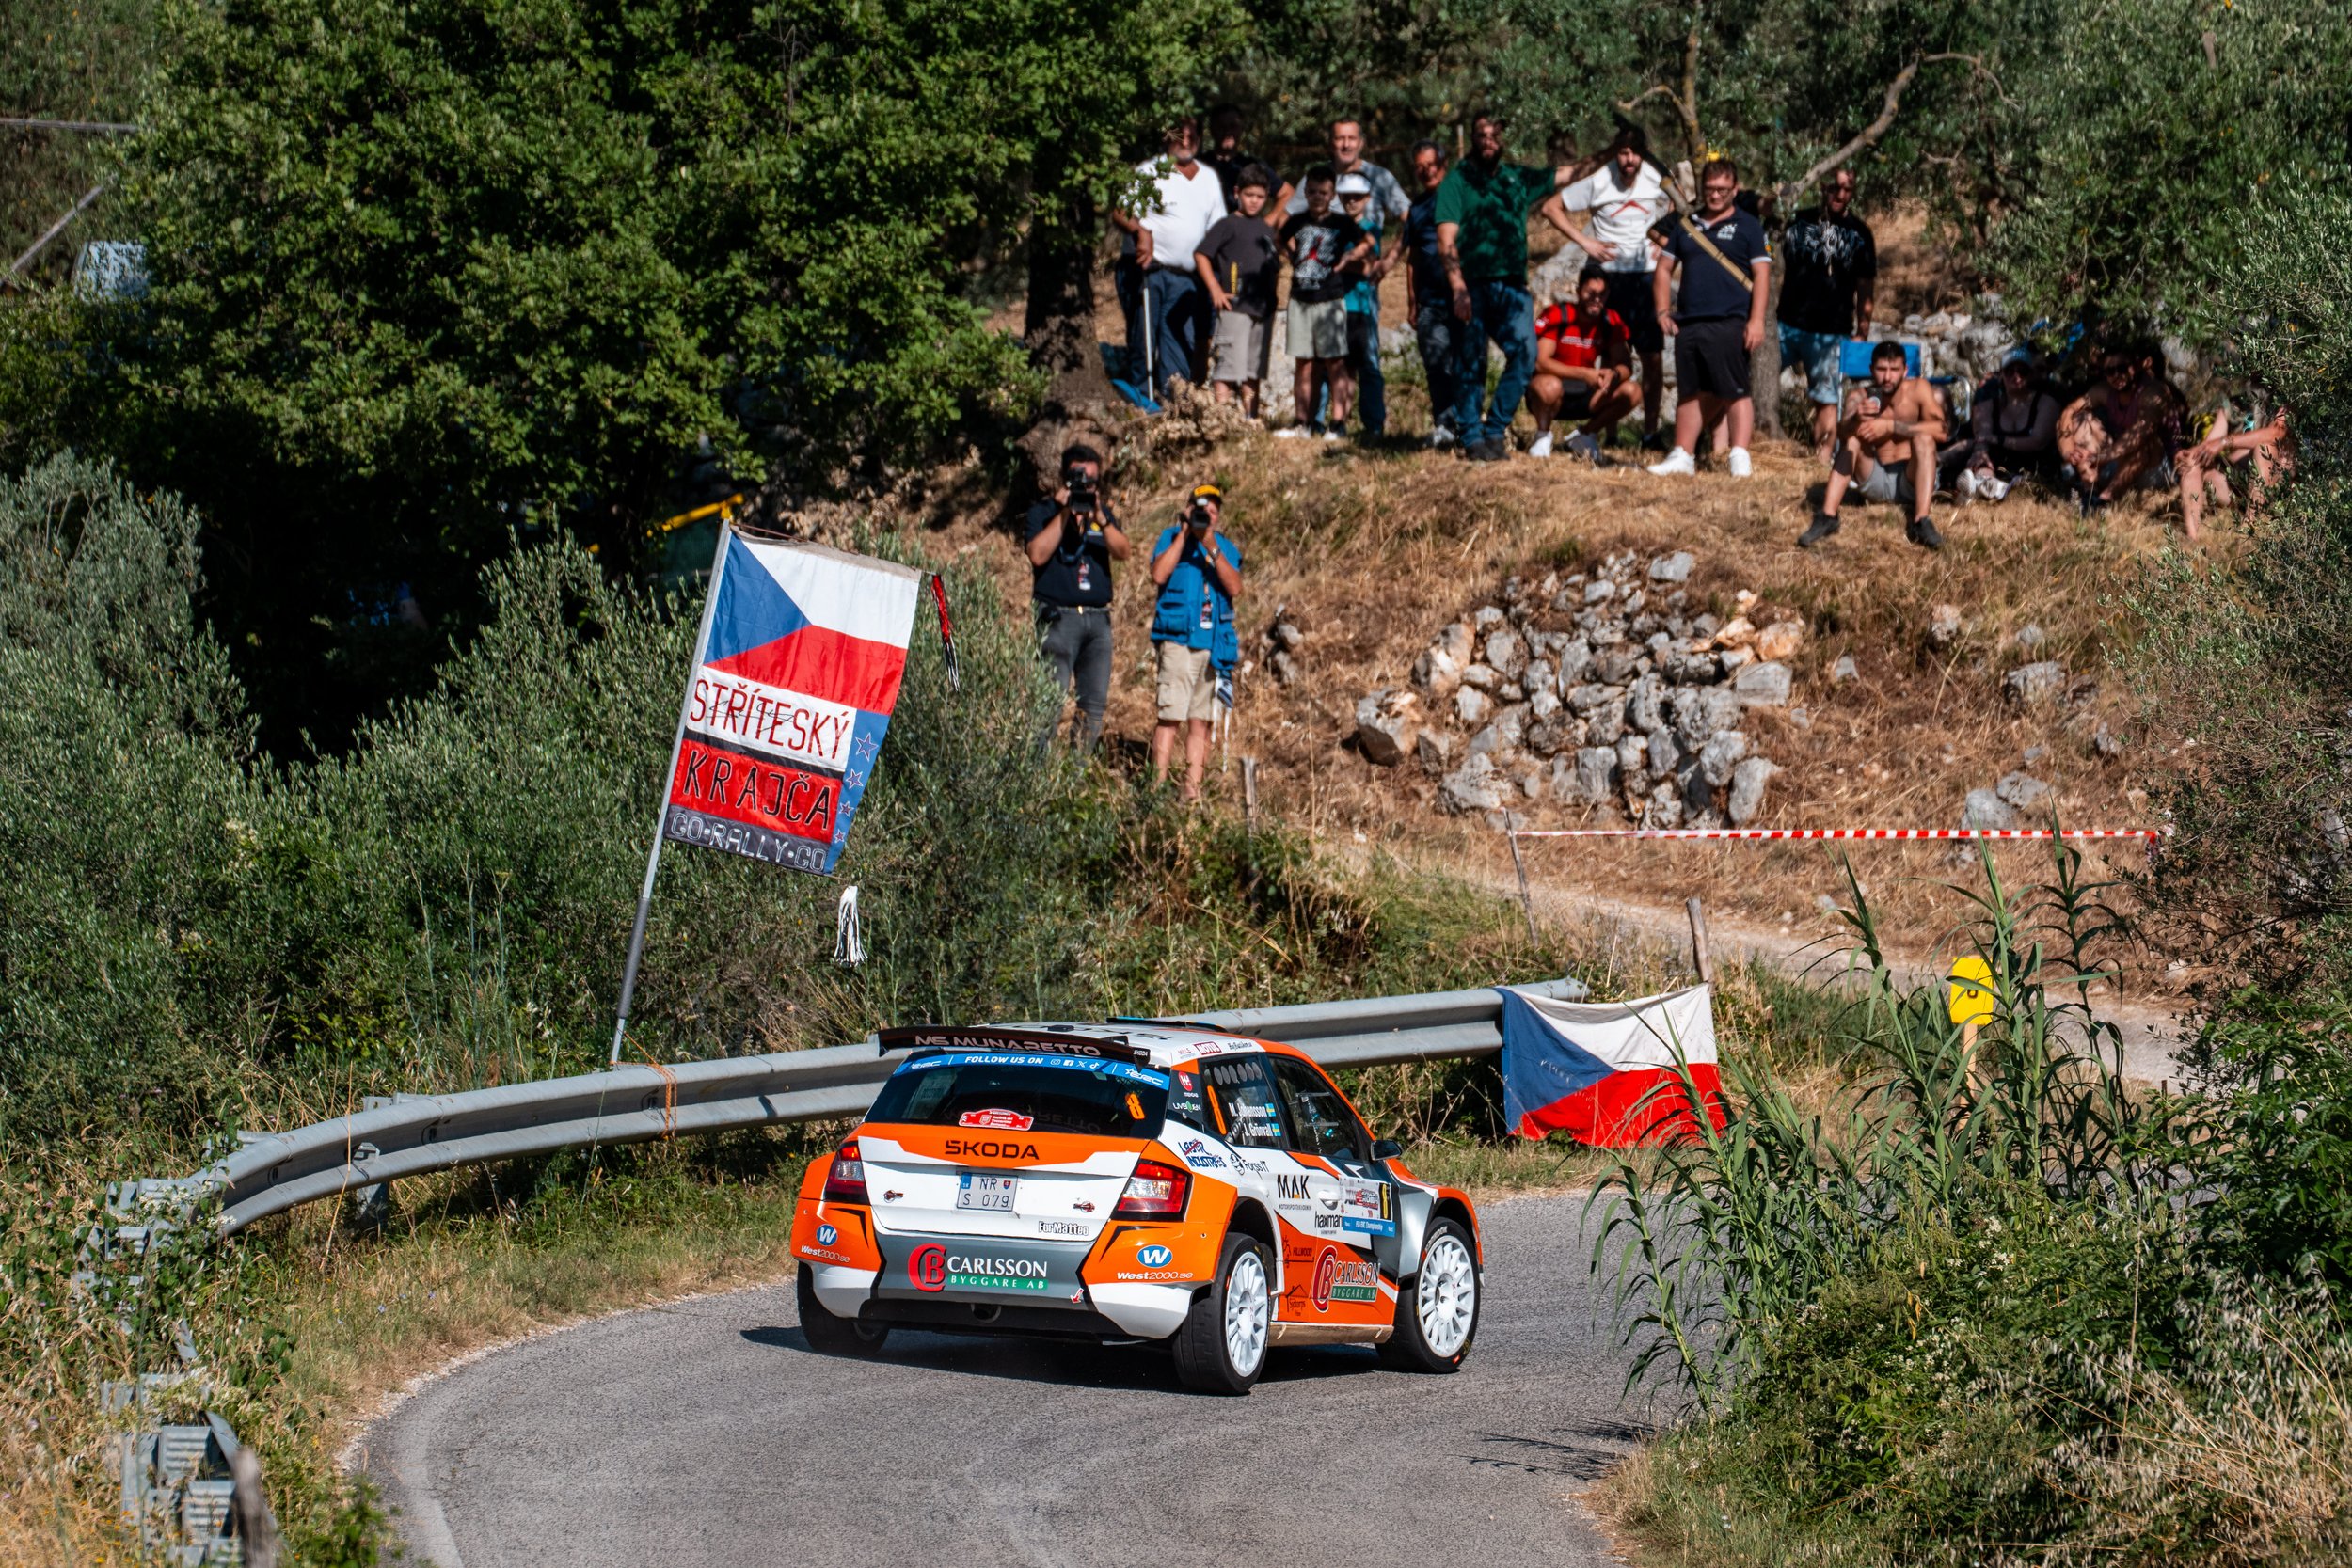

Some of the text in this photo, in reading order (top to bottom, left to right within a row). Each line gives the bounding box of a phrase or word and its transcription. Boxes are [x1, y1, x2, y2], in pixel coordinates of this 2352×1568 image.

[690, 679, 850, 759] STŘÍTESKÝ
[683, 751, 831, 830] KRAJČA
[914, 1035, 1101, 1056] MS MUNARETTO
[1125, 1092, 1145, 1120] 8
[979, 1178, 998, 1190] NR
[1277, 1174, 1311, 1199] MAK
[962, 1193, 1009, 1208] S 079
[819, 1227, 837, 1243] W
[1038, 1221, 1089, 1236] ForMatteo
[1143, 1247, 1171, 1264] W
[946, 1256, 1047, 1277] CARLSSON
[1333, 1261, 1380, 1284] CARLSSON
[950, 1275, 1044, 1289] BYGGARE AB
[1332, 1287, 1375, 1299] BYGGARE AB
